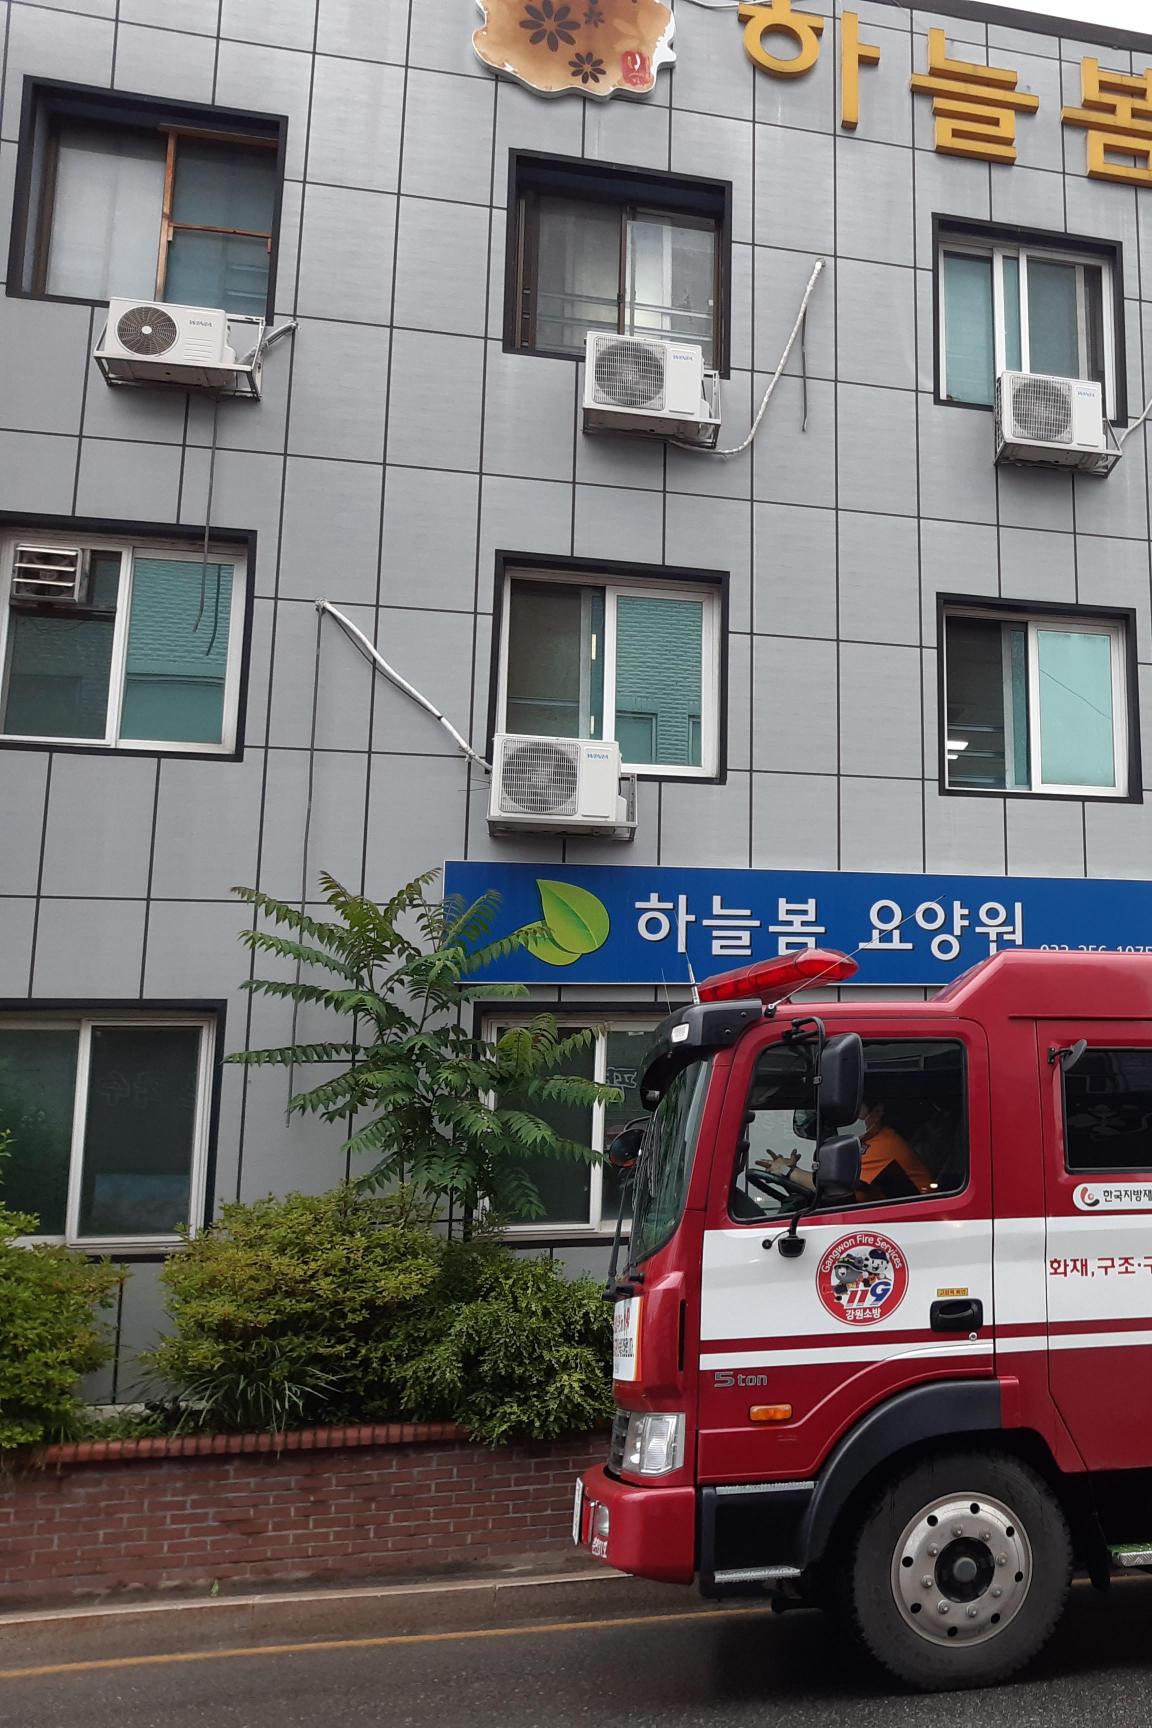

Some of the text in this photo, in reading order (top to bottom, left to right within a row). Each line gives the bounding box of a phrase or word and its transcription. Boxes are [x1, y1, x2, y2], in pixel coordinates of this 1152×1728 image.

[635, 892, 1023, 961] 하늘봄 요양원
[821, 1234, 903, 1273] Gangwon Fire Services
[845, 1280, 892, 1307] 119
[846, 1307, 881, 1320] 강원소방
